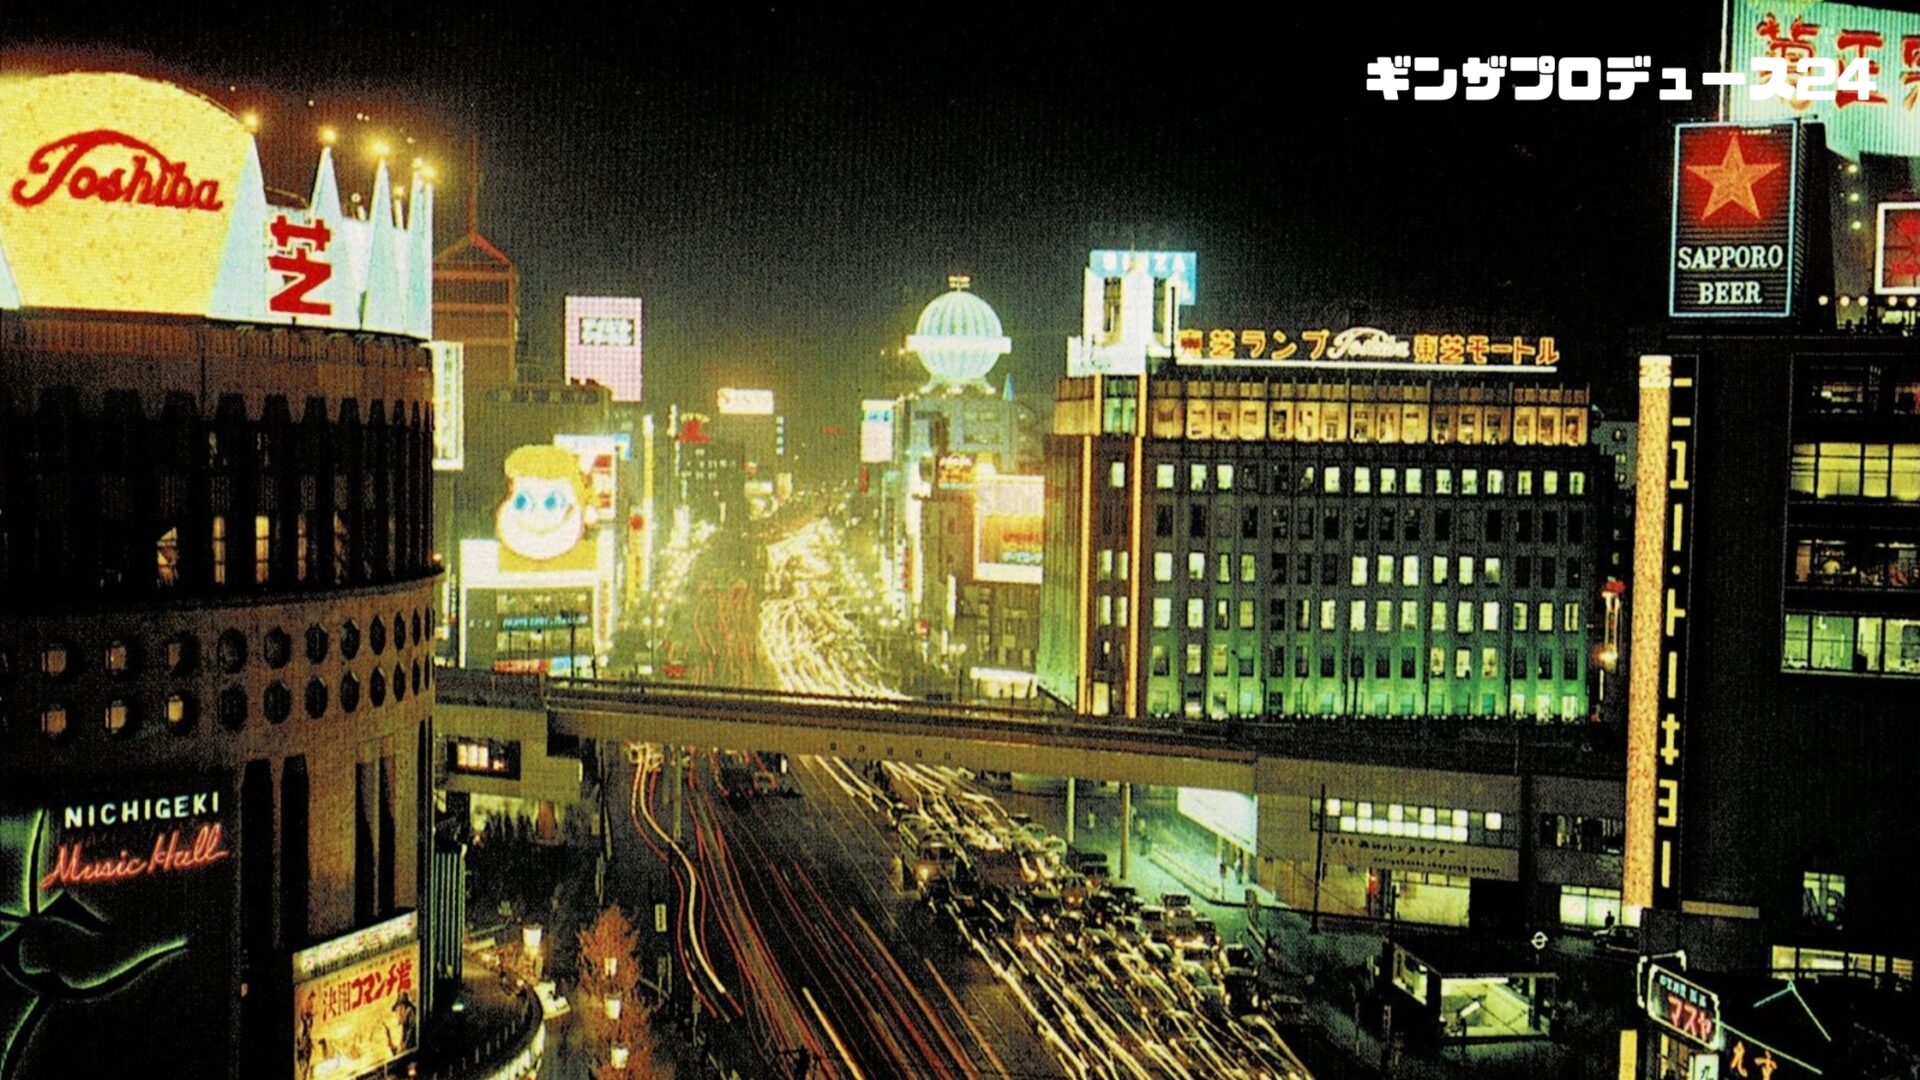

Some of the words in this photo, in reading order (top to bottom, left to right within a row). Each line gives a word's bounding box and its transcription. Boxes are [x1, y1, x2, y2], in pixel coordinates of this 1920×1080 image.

[12, 130, 224, 211] Toshiba
[1677, 244, 1784, 269] SAPPORO
[1698, 280, 1763, 305] BEER
[1179, 329, 1329, 361] 東芝ランプ
[1327, 326, 1411, 359] Toshiba
[1413, 333, 1560, 366] 東芝モートル
[64, 791, 220, 829] NICHIGEKI
[38, 842, 149, 889] Music
[147, 822, 230, 873] Hall
